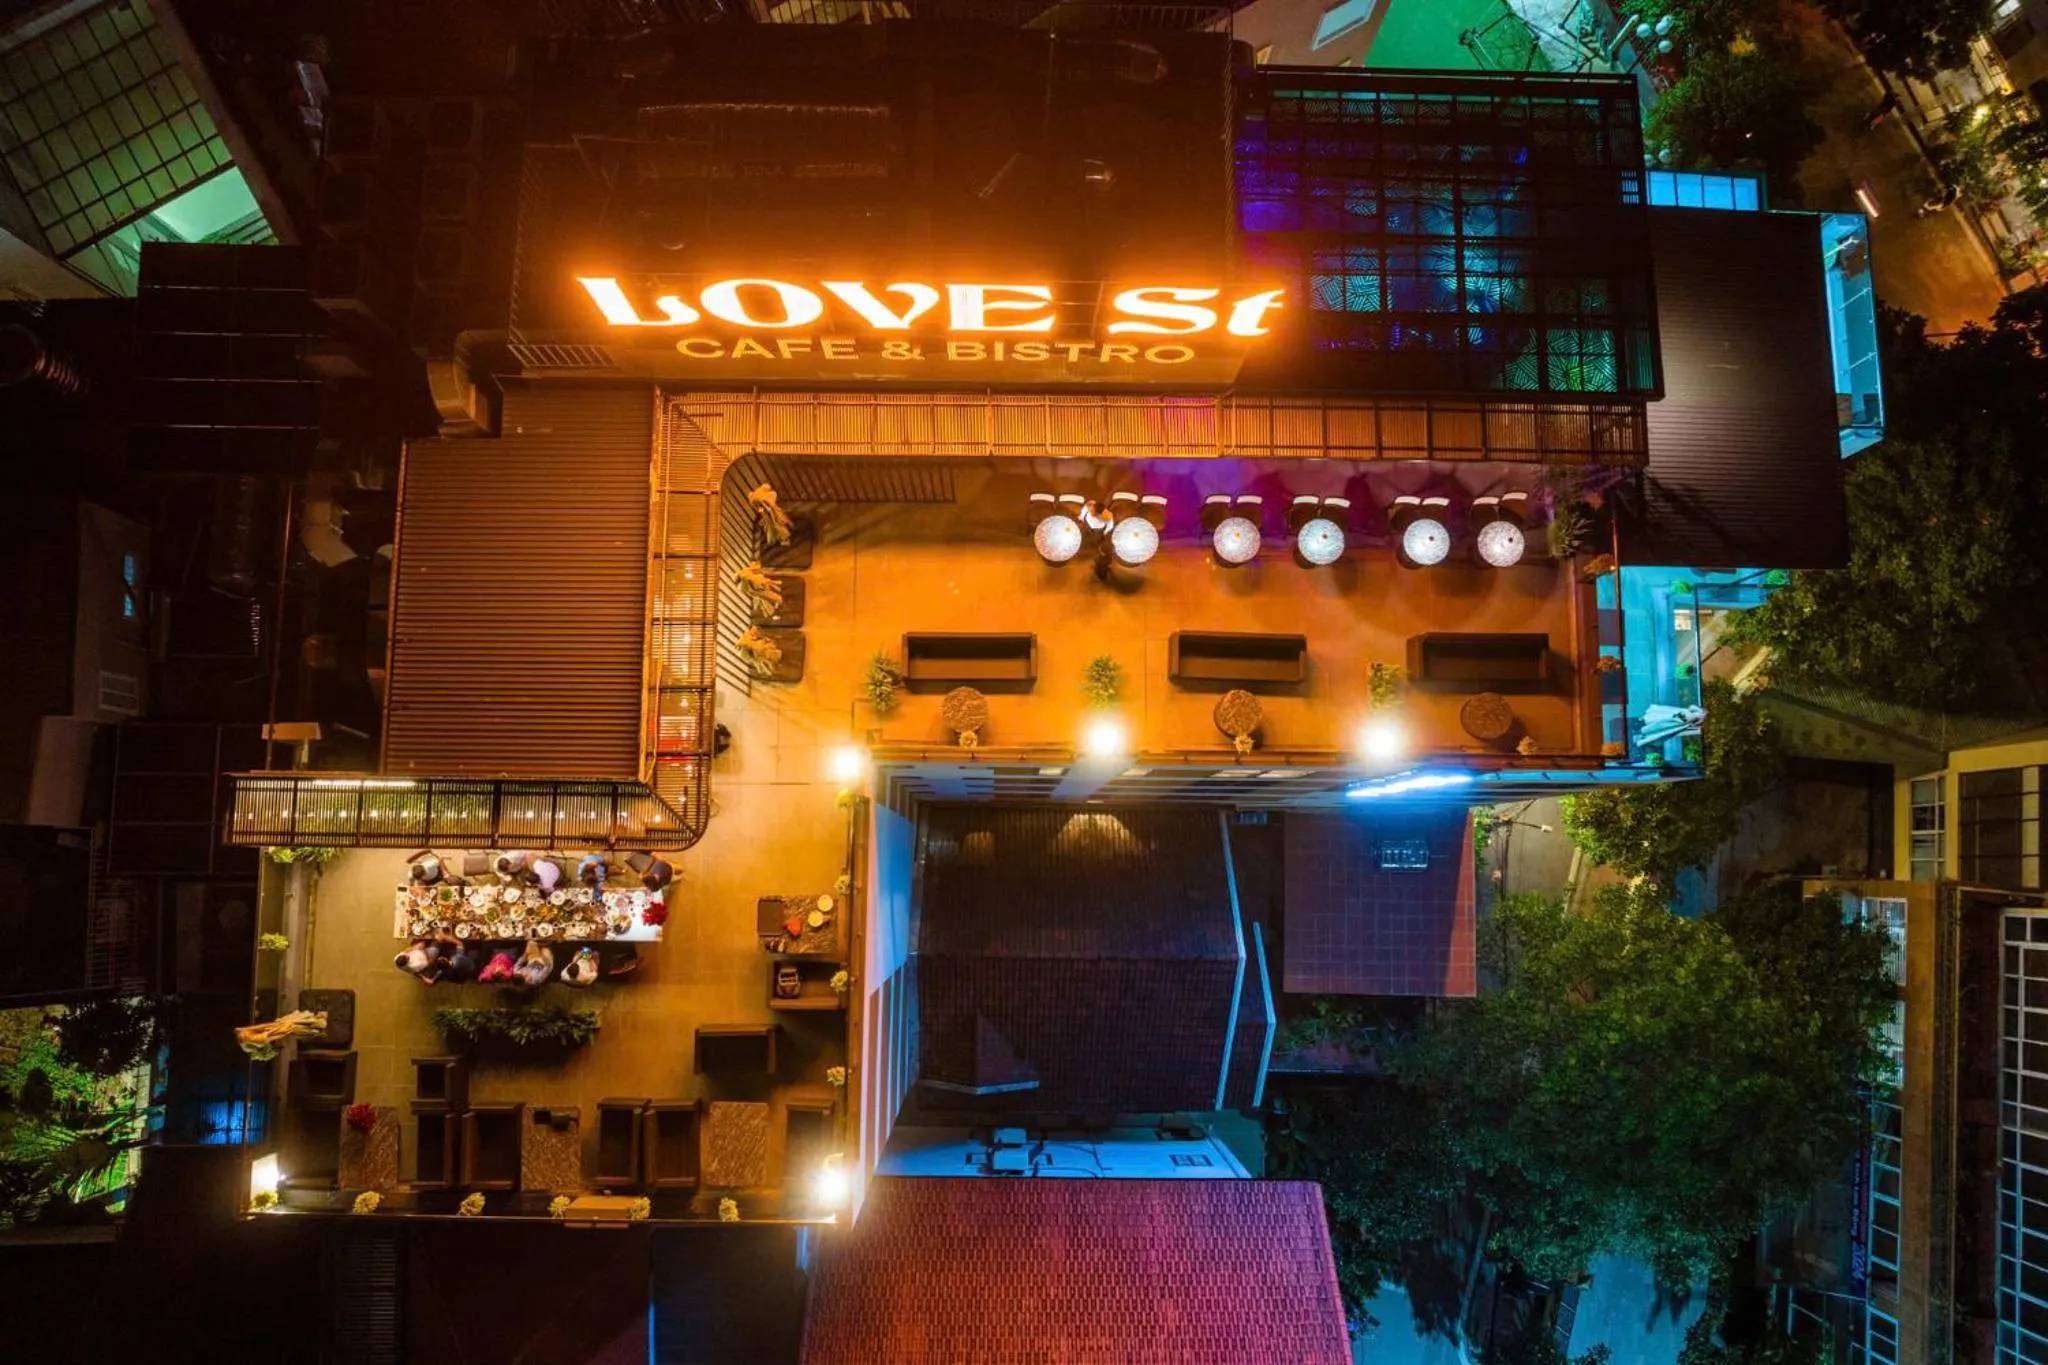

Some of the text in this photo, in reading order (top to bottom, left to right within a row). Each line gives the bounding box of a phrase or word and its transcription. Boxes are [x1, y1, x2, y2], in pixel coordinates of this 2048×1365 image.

[576, 277, 1285, 336] LOVE St
[676, 337, 1196, 364] CAFE & BISTRO
